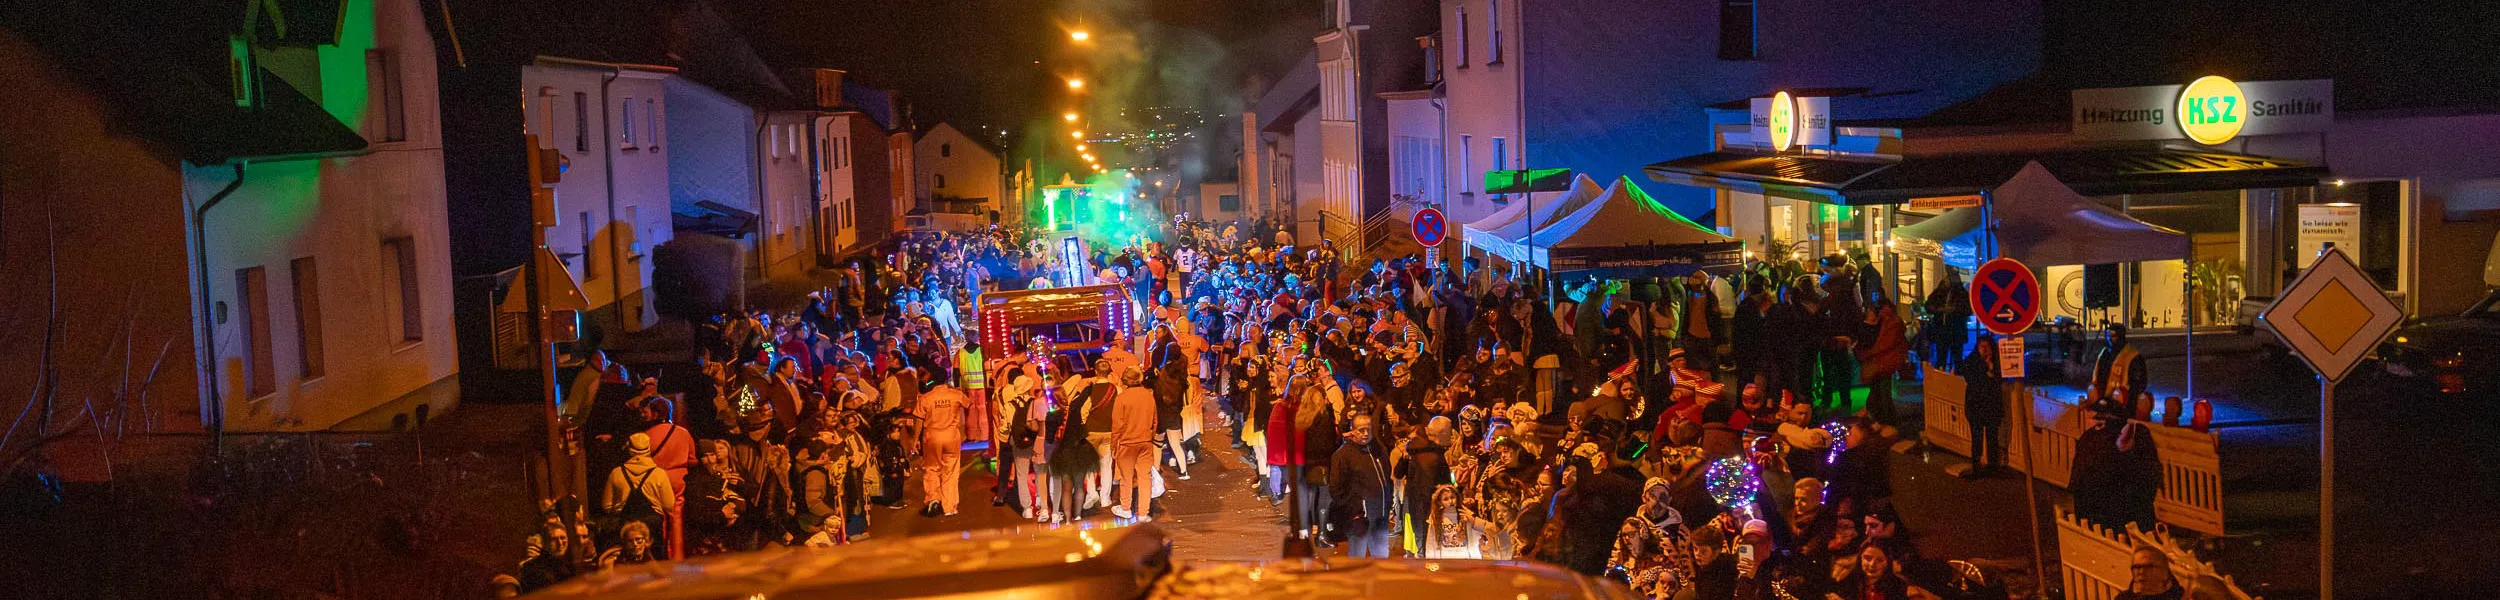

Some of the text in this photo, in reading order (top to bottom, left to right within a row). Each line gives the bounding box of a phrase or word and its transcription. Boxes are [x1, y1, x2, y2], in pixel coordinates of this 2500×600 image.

[2082, 95, 2323, 125] Heizung KSZ Sanitär
[1182, 255, 1189, 266] 2
